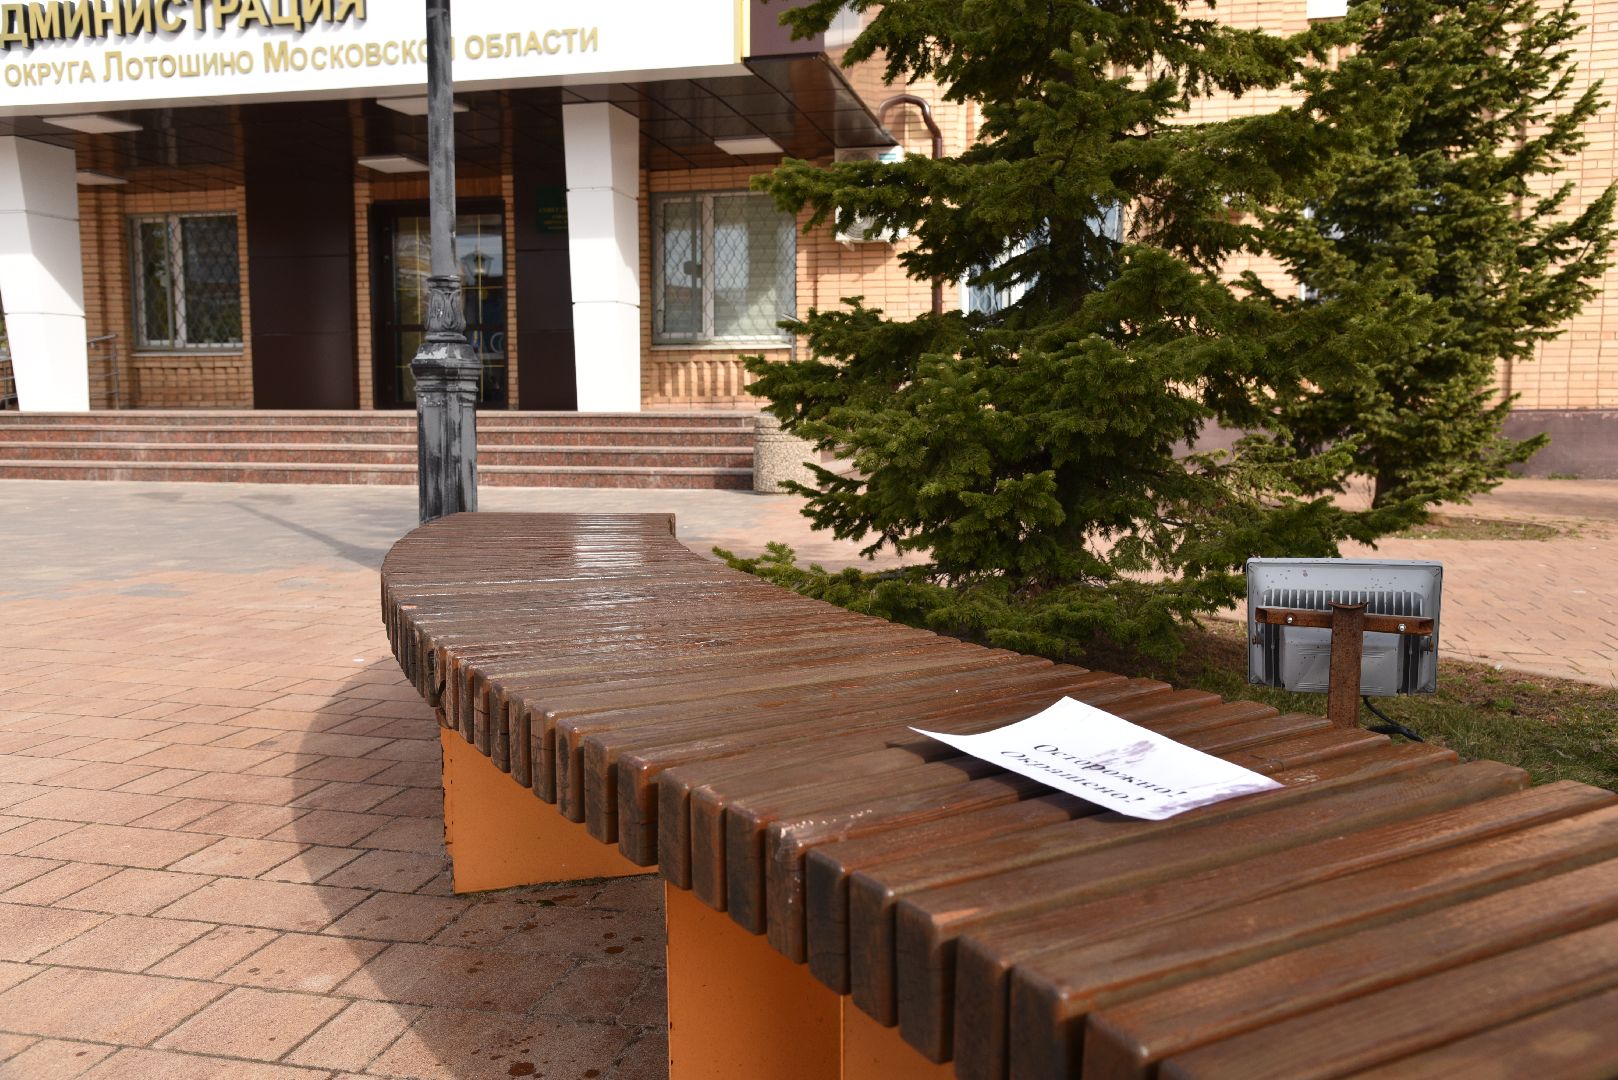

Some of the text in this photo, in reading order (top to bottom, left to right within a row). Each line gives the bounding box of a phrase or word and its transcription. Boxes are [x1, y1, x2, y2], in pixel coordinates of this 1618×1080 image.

[263, 36, 455, 73] МОСКОВСКО
[1000, 750, 1146, 803] Окрашено!
[1033, 744, 1188, 798] Осторожно!
